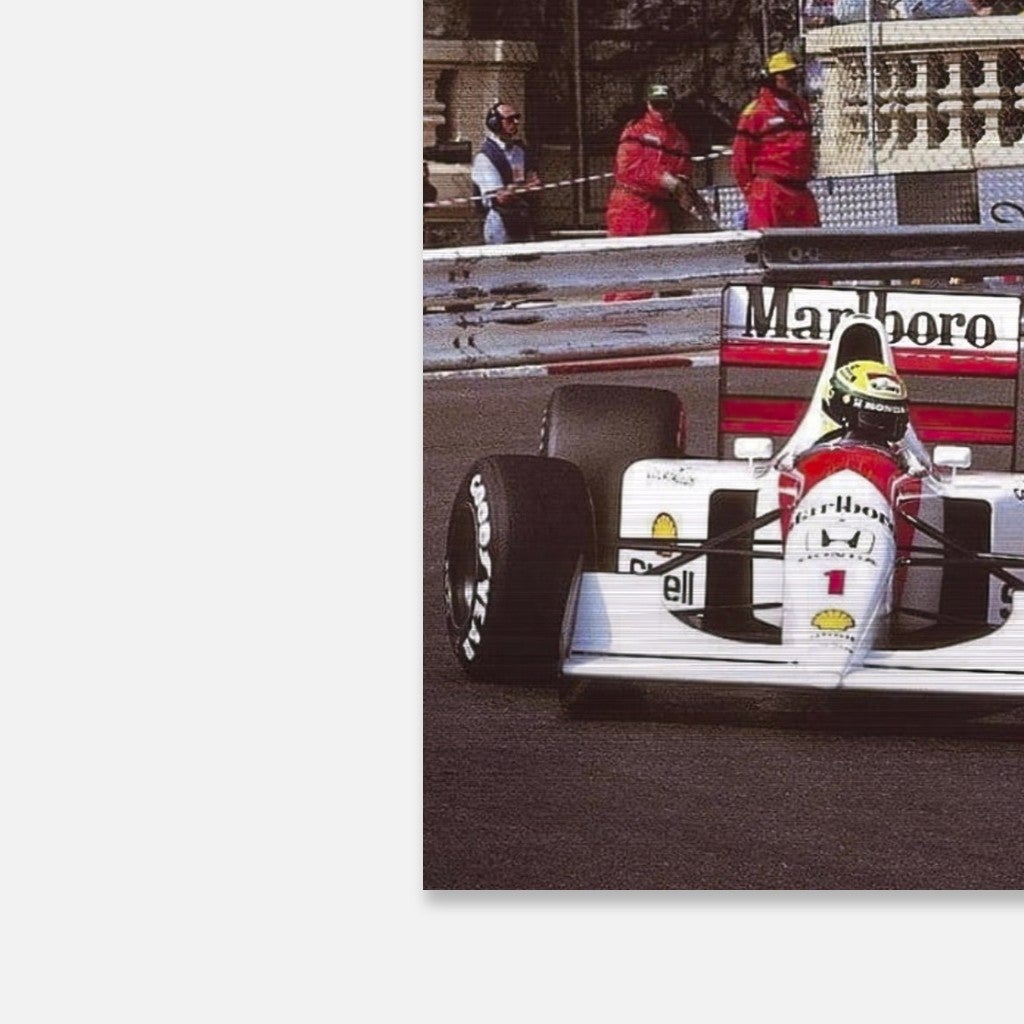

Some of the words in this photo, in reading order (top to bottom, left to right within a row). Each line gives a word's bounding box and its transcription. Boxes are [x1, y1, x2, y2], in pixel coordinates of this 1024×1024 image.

[790, 495, 894, 531] arlbor
[630, 558, 694, 606] ell
[824, 569, 847, 596] 1
